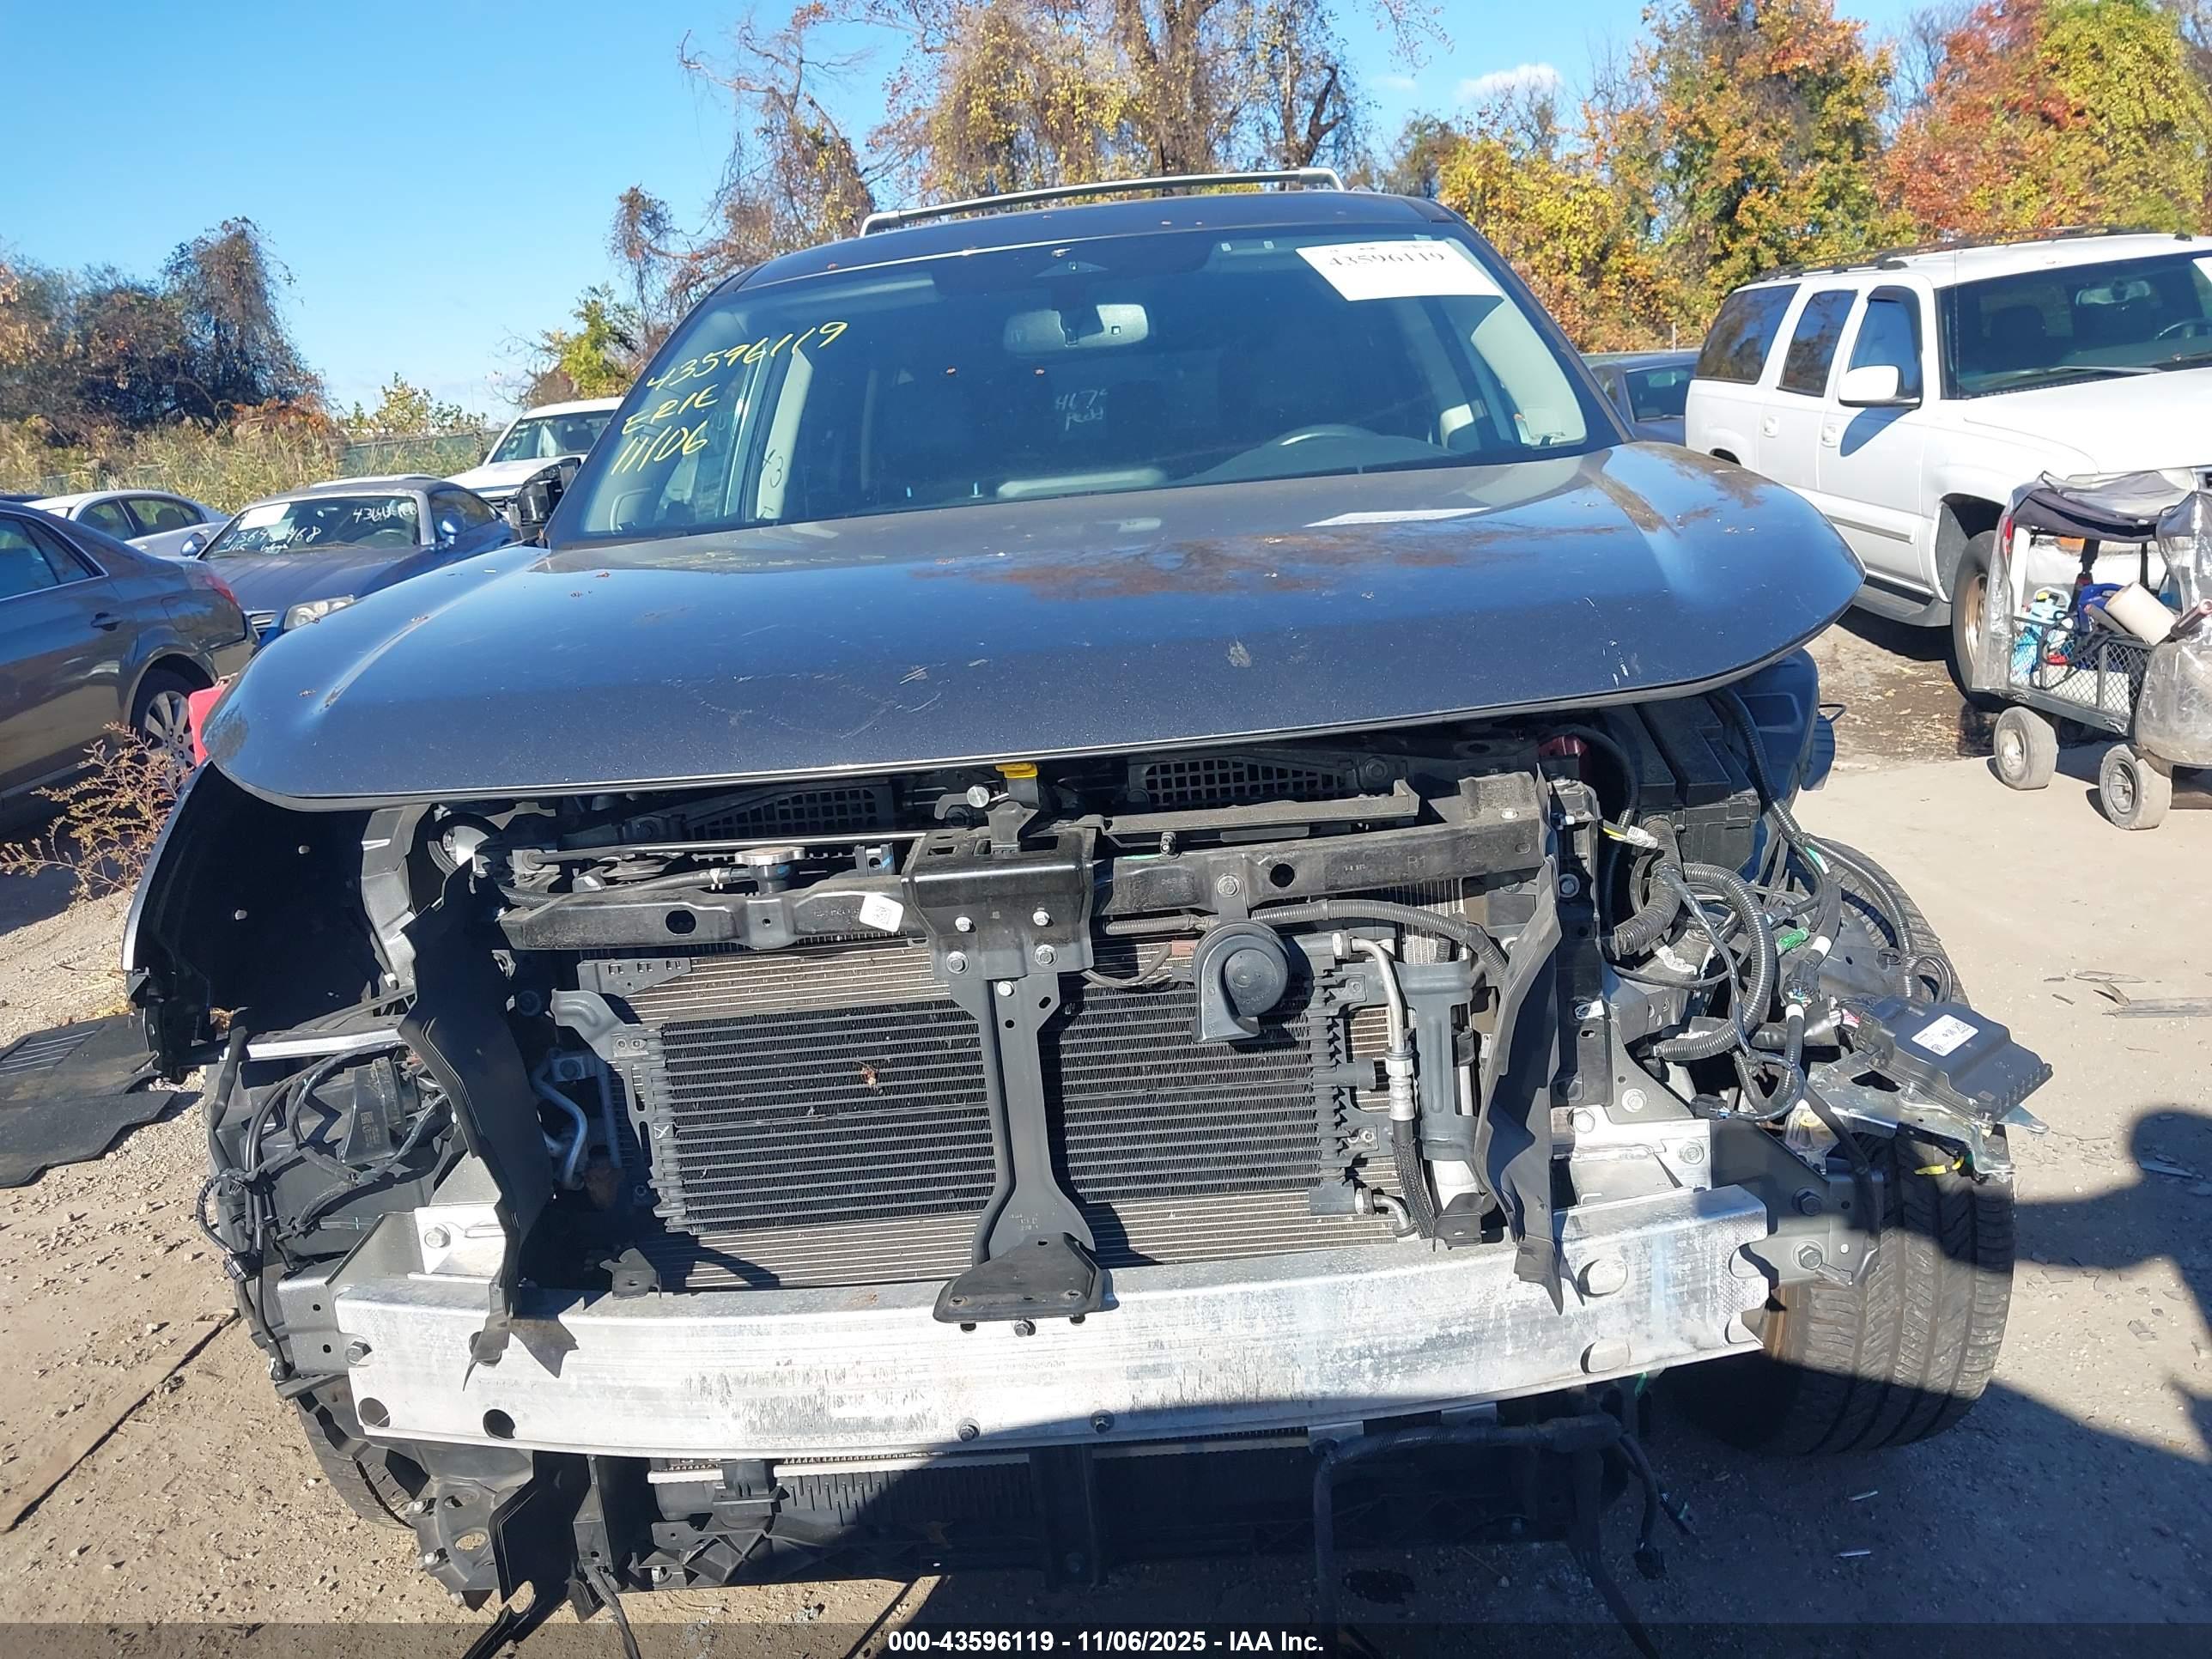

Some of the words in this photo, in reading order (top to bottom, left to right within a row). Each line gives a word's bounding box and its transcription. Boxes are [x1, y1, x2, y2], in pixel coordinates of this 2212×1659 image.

[1328, 251, 1446, 266] 43596119
[647, 321, 848, 392] 43596119
[621, 383, 720, 435] ERIE
